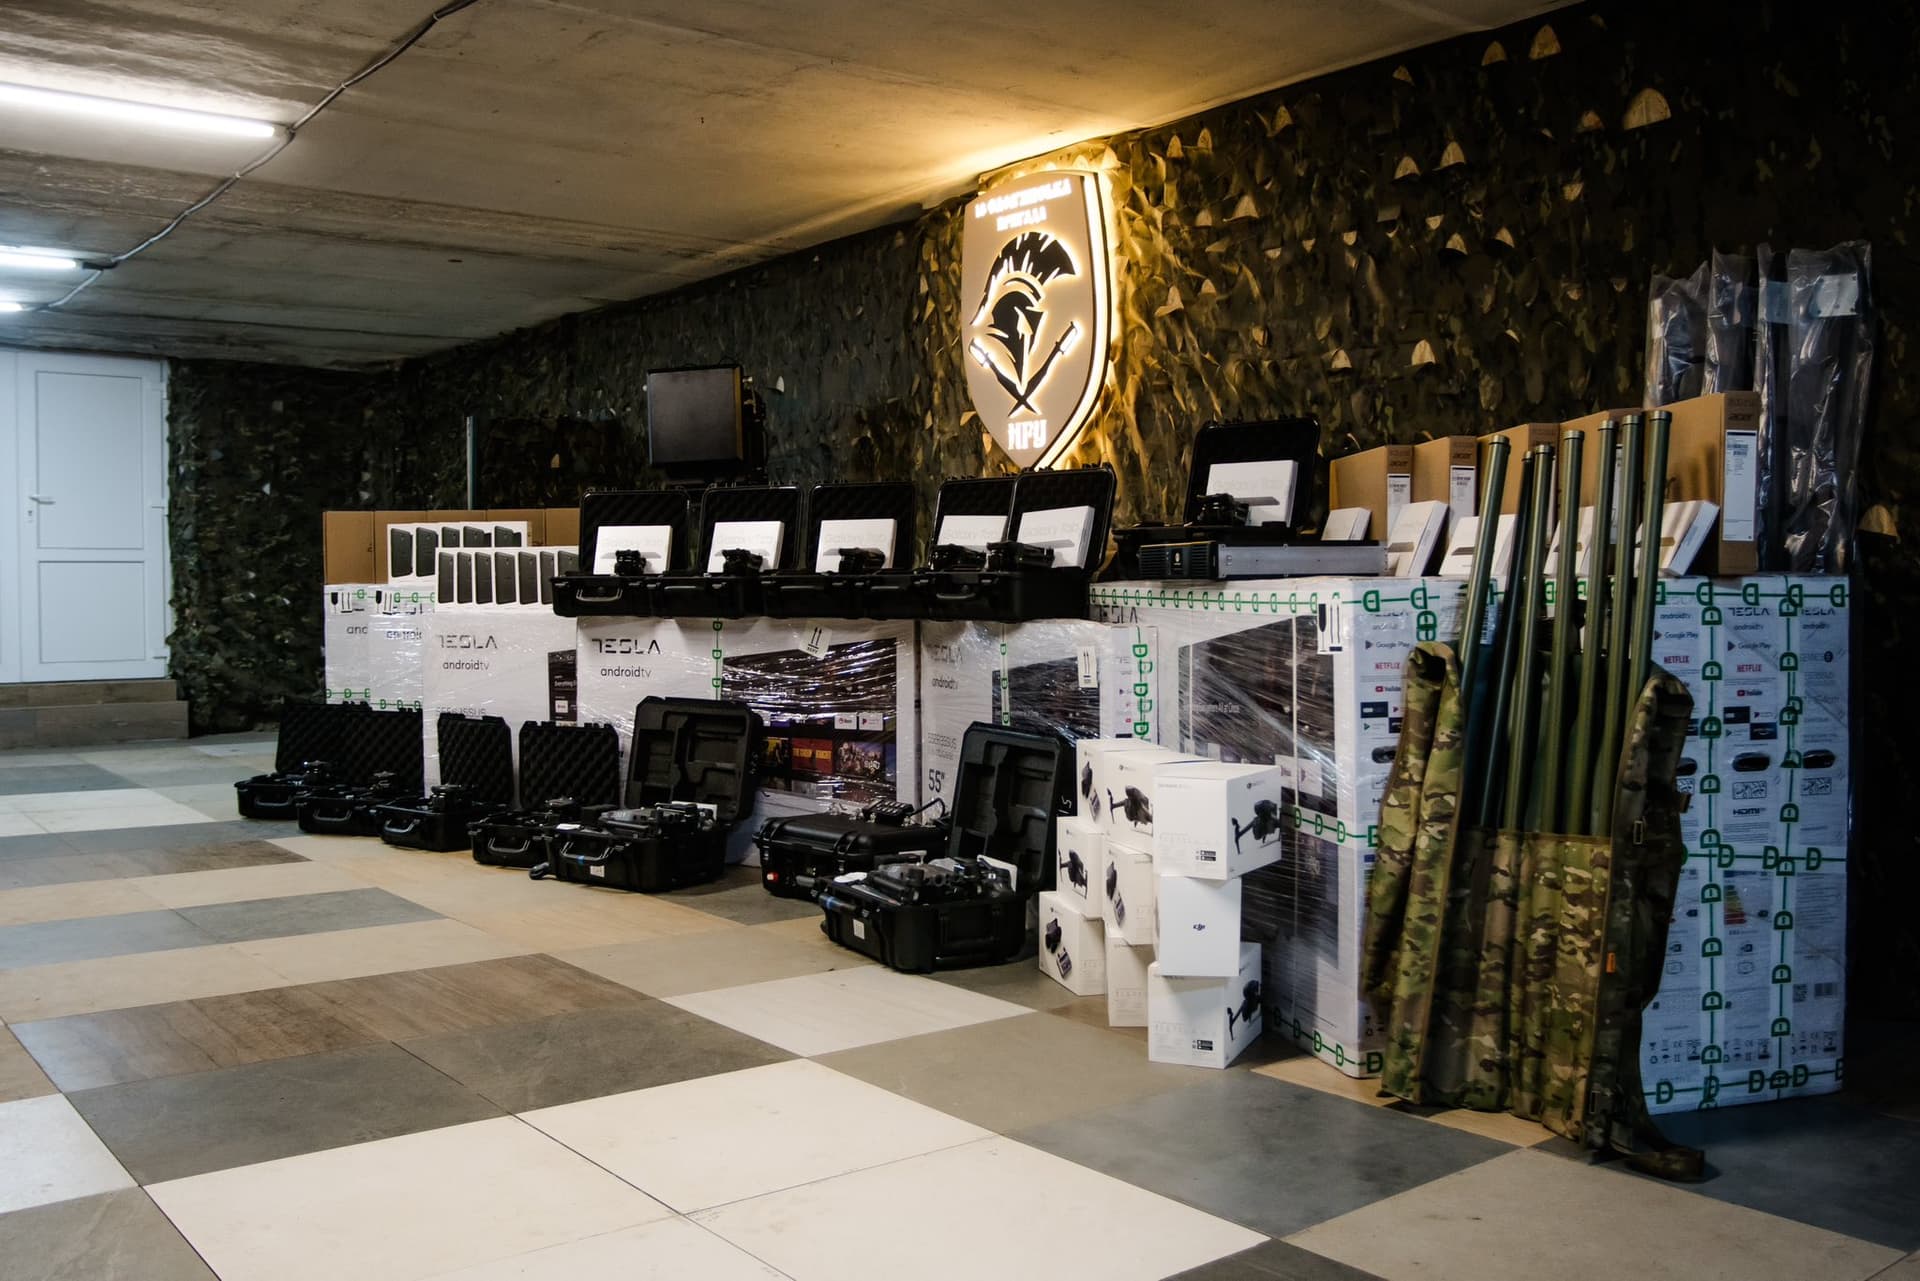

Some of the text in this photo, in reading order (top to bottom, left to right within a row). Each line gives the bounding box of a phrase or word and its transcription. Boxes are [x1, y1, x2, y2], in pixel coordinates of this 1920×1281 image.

[1728, 607, 1770, 616] TESLA
[437, 634, 498, 649] TESLA
[592, 638, 661, 655] TESLA
[1663, 655, 1690, 665] NETFLIX
[443, 660, 490, 671] androidtv
[1375, 662, 1401, 670] NETFLIX
[1736, 664, 1762, 672] NETFLIX
[600, 666, 652, 678] androidtv
